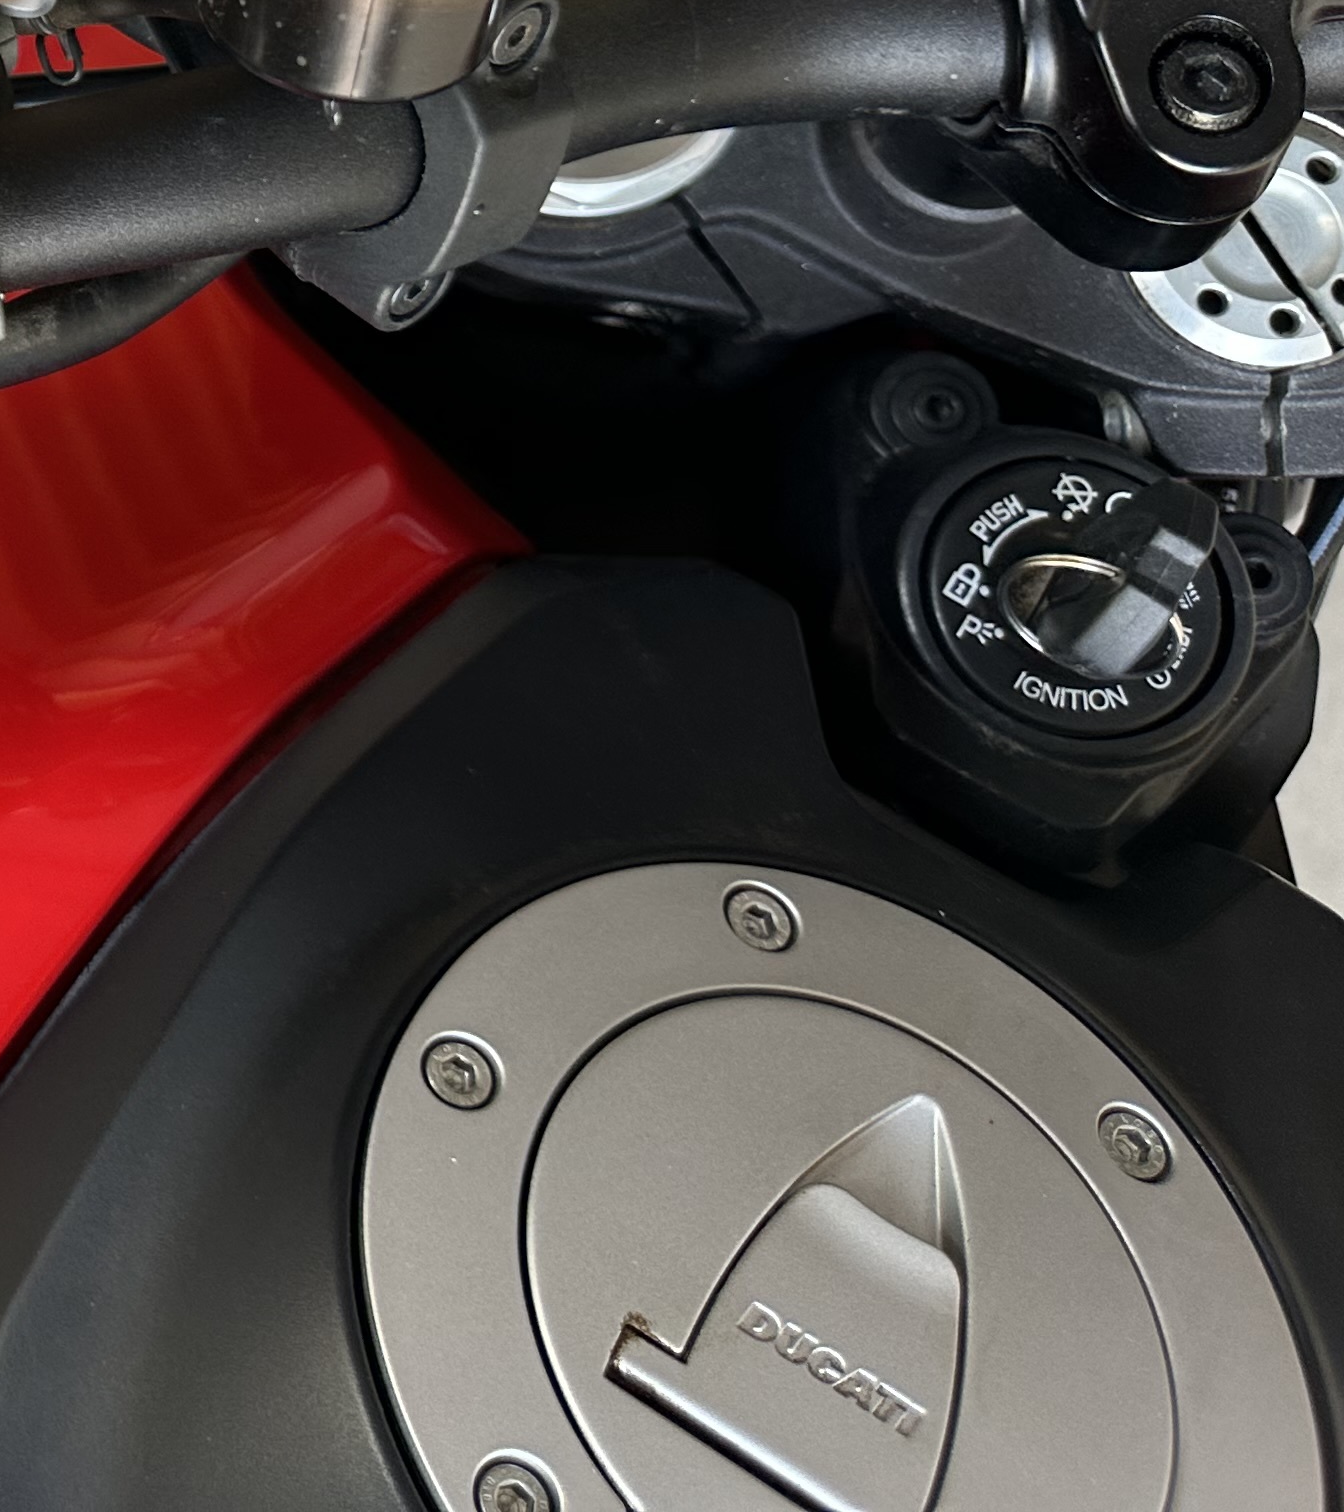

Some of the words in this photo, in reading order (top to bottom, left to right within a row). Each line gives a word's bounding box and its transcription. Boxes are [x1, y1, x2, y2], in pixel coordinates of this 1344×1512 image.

[969, 494, 1024, 541] PUSH
[1013, 670, 1129, 712] IGNITION
[736, 1300, 928, 1437] DUCATI
